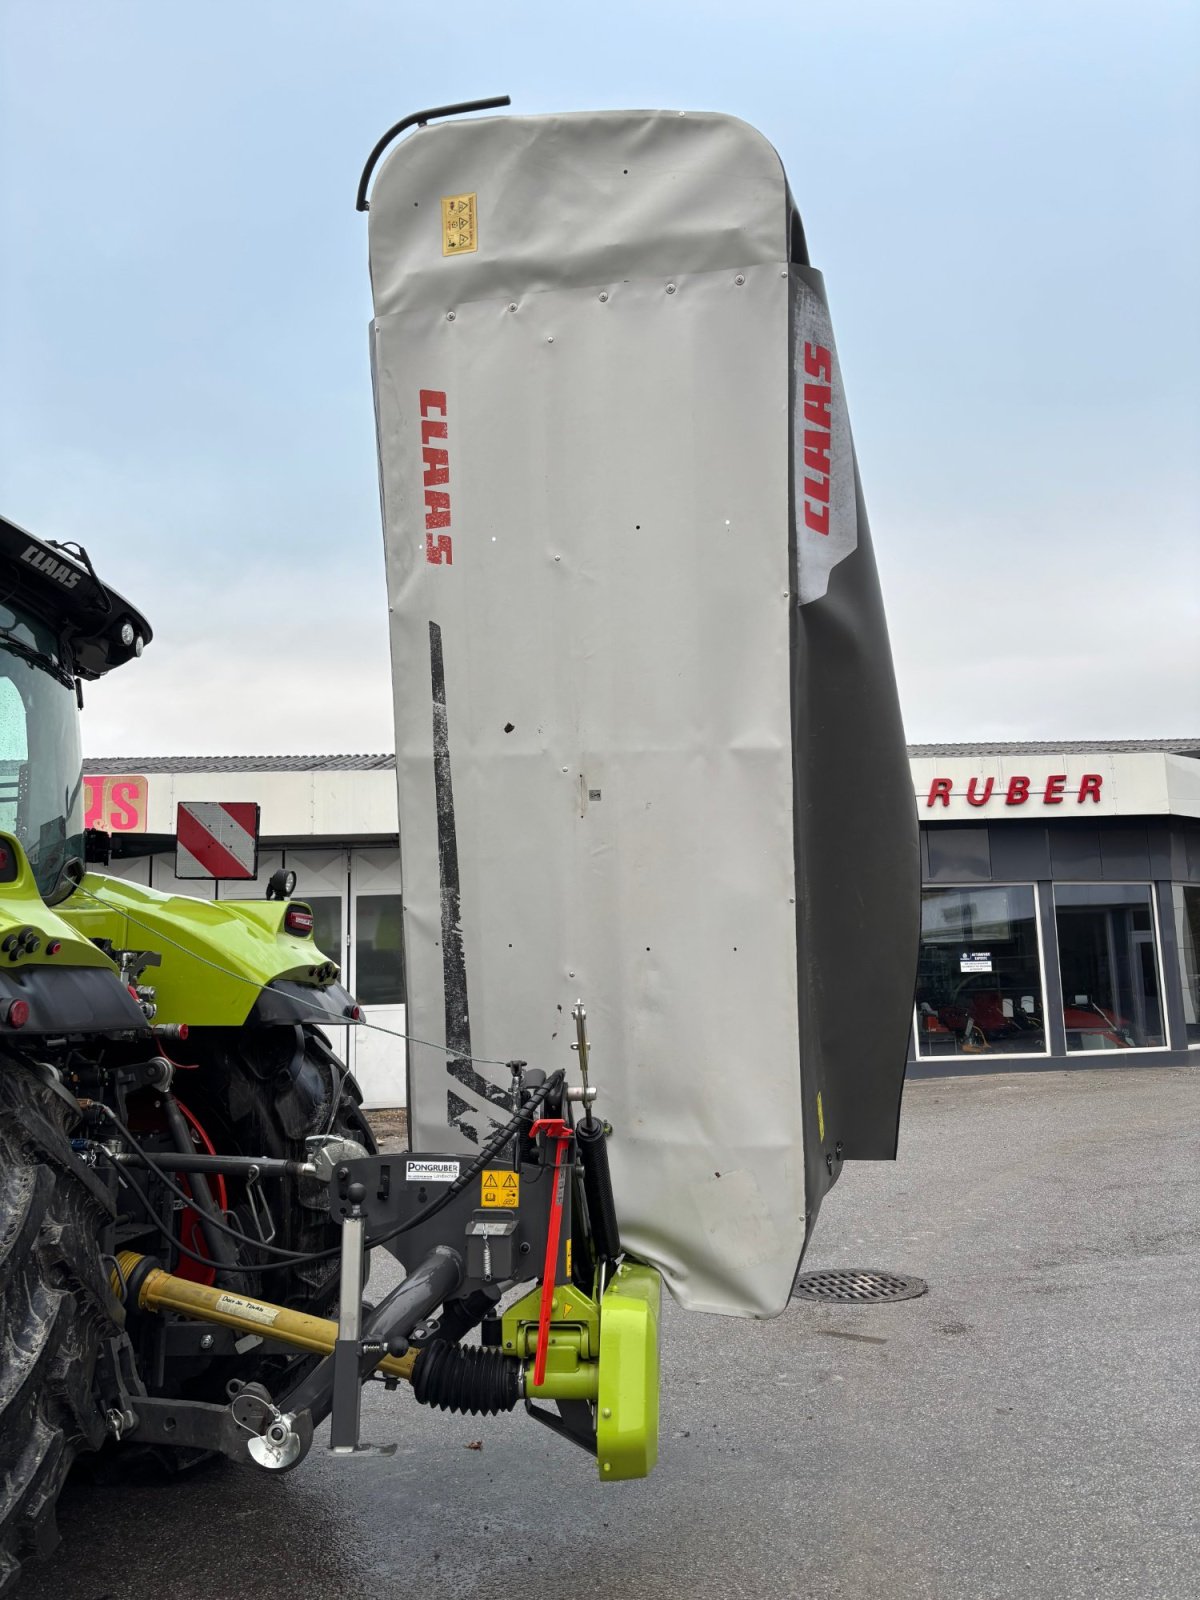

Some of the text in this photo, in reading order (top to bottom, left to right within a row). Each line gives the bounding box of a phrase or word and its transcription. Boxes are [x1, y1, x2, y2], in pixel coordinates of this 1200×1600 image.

[419, 389, 453, 565] CLAAS
[804, 341, 832, 537] CLAAS
[20, 545, 82, 589] CLAAS
[926, 774, 1103, 807] RUBER
